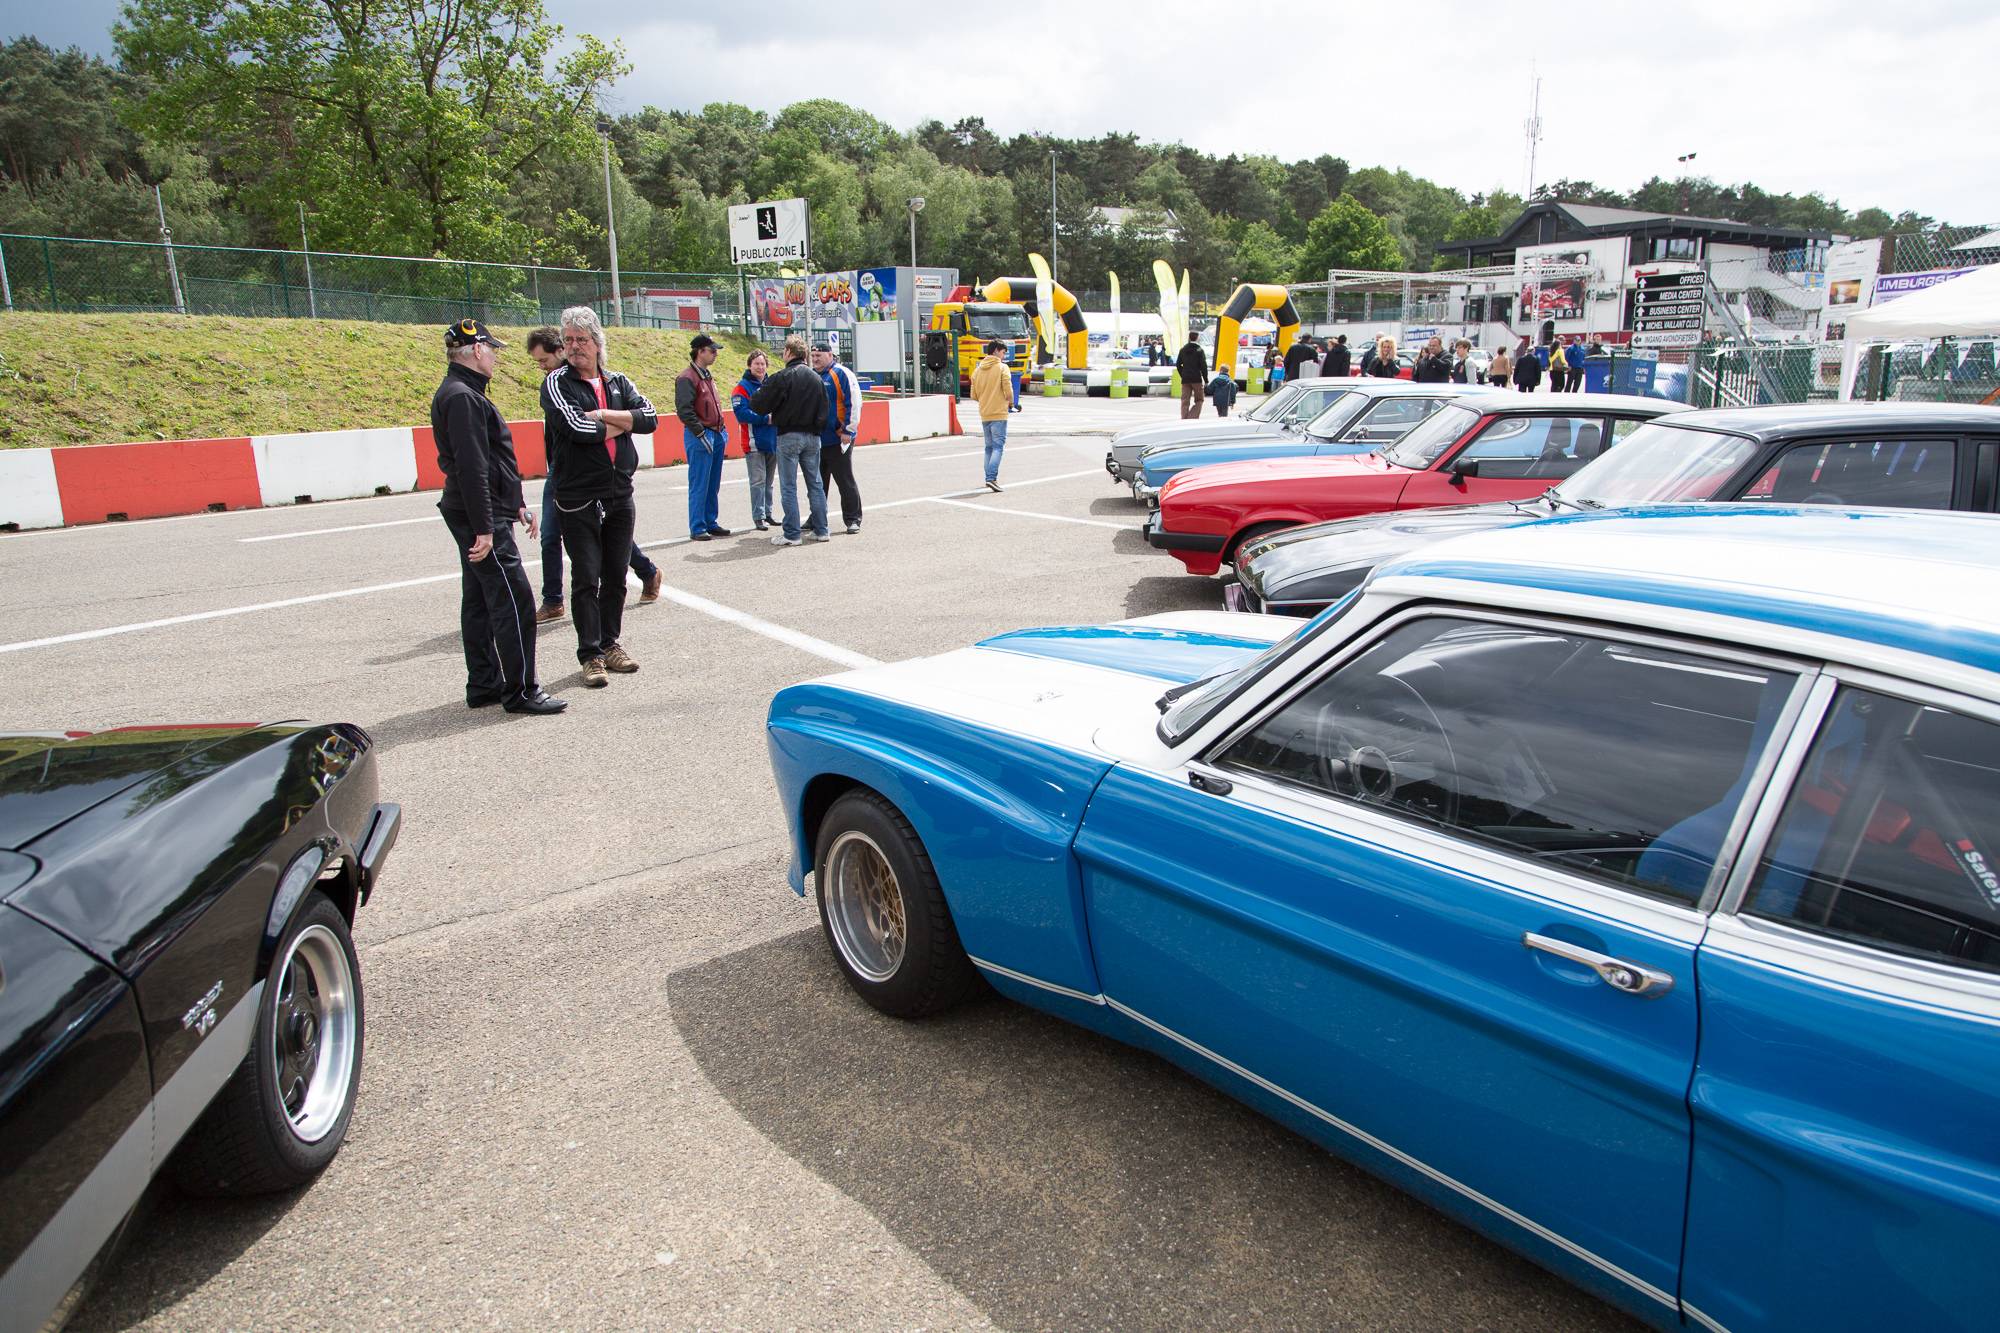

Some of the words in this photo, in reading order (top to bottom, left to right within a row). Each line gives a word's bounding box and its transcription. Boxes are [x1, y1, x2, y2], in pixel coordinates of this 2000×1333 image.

[741, 248, 771, 259] PUBLIC
[773, 246, 797, 257] ZONE
[1679, 275, 1704, 285] OFFICES
[784, 282, 810, 306] KID
[818, 279, 852, 304] CARS
[1659, 290, 1678, 300] MEDIA
[1678, 290, 1702, 299] CENTER
[818, 307, 842, 318] circuit
[1649, 305, 1677, 316] BUSINESS
[1677, 304, 1701, 314] CENTER
[1645, 321, 1663, 330] MICHEL
[1663, 320, 1686, 329] VAILLANT
[1686, 319, 1700, 328] CLUB
[195, 1008, 217, 1037] V6
